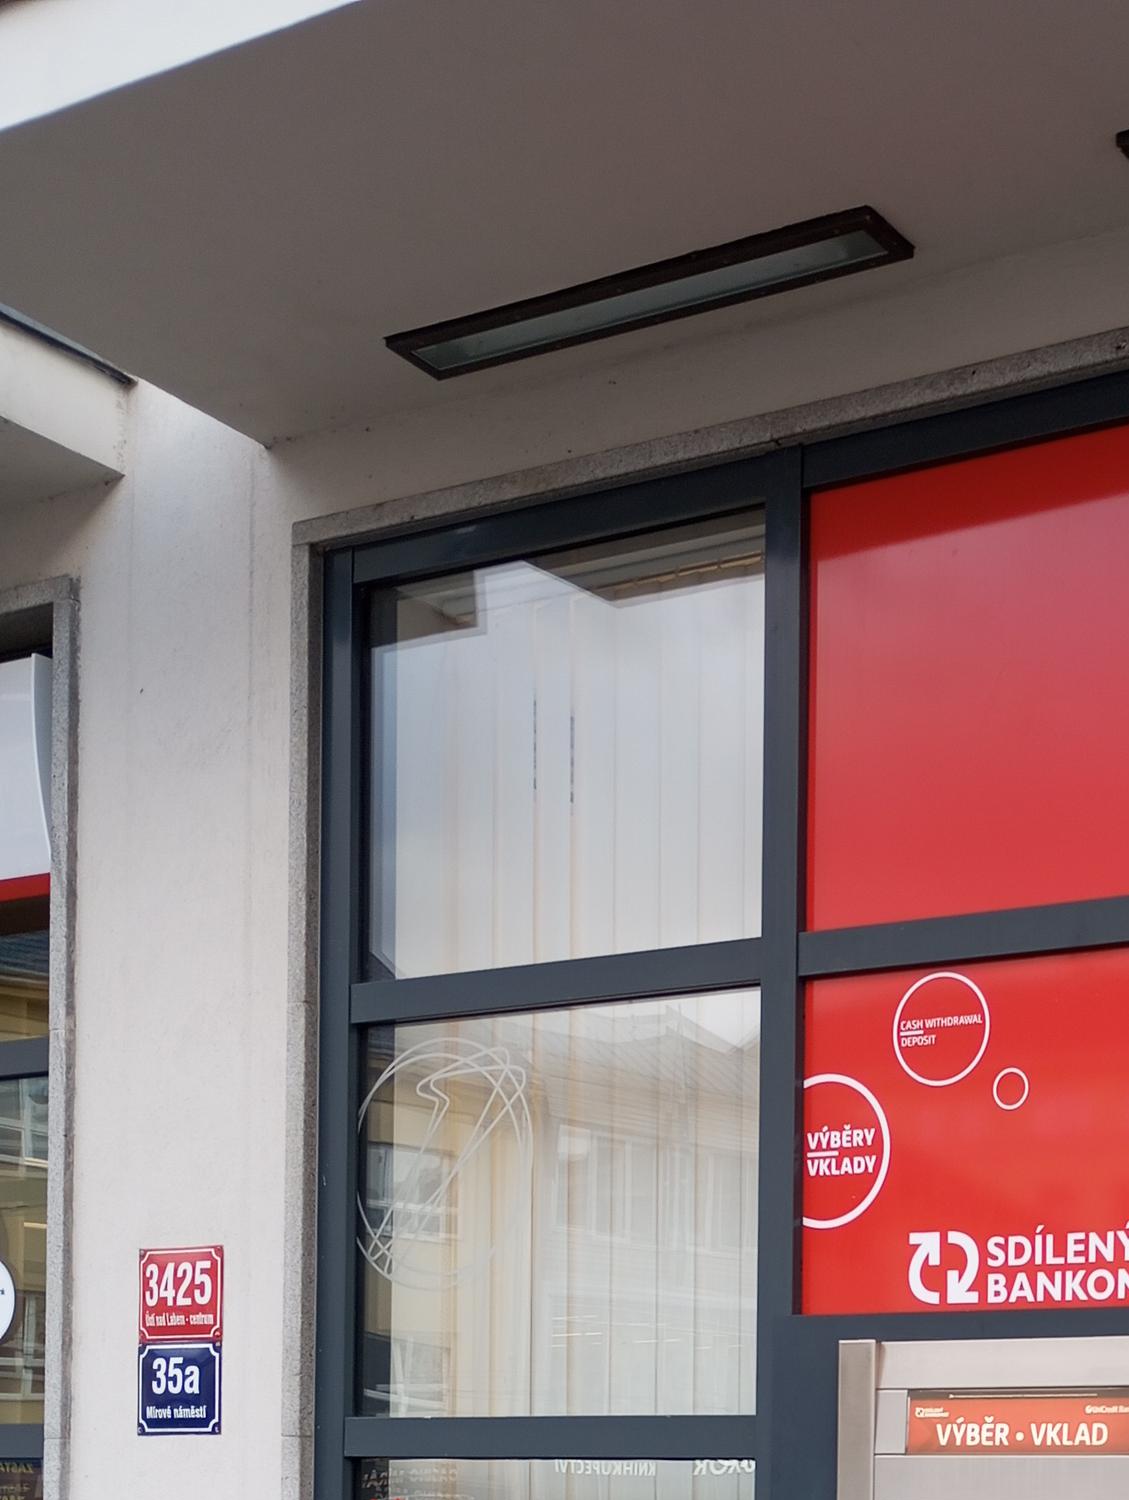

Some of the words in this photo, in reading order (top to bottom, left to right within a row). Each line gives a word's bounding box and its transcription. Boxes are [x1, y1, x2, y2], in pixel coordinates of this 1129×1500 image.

[900, 1019, 924, 1031] CASH
[924, 1013, 983, 1029] WITHDRAWAL
[901, 1034, 936, 1048] DEPOSIT
[806, 1123, 876, 1151] VÝBĚRY
[806, 1155, 877, 1177] VKLADY
[144, 1259, 213, 1307] 3425
[151, 1356, 200, 1395] 35a
[146, 1405, 172, 1419] Mírové
[173, 1405, 207, 1419] náměstí
[935, 1415, 1010, 1446] VÝBĚR
[1030, 1422, 1108, 1446] VKLAD
